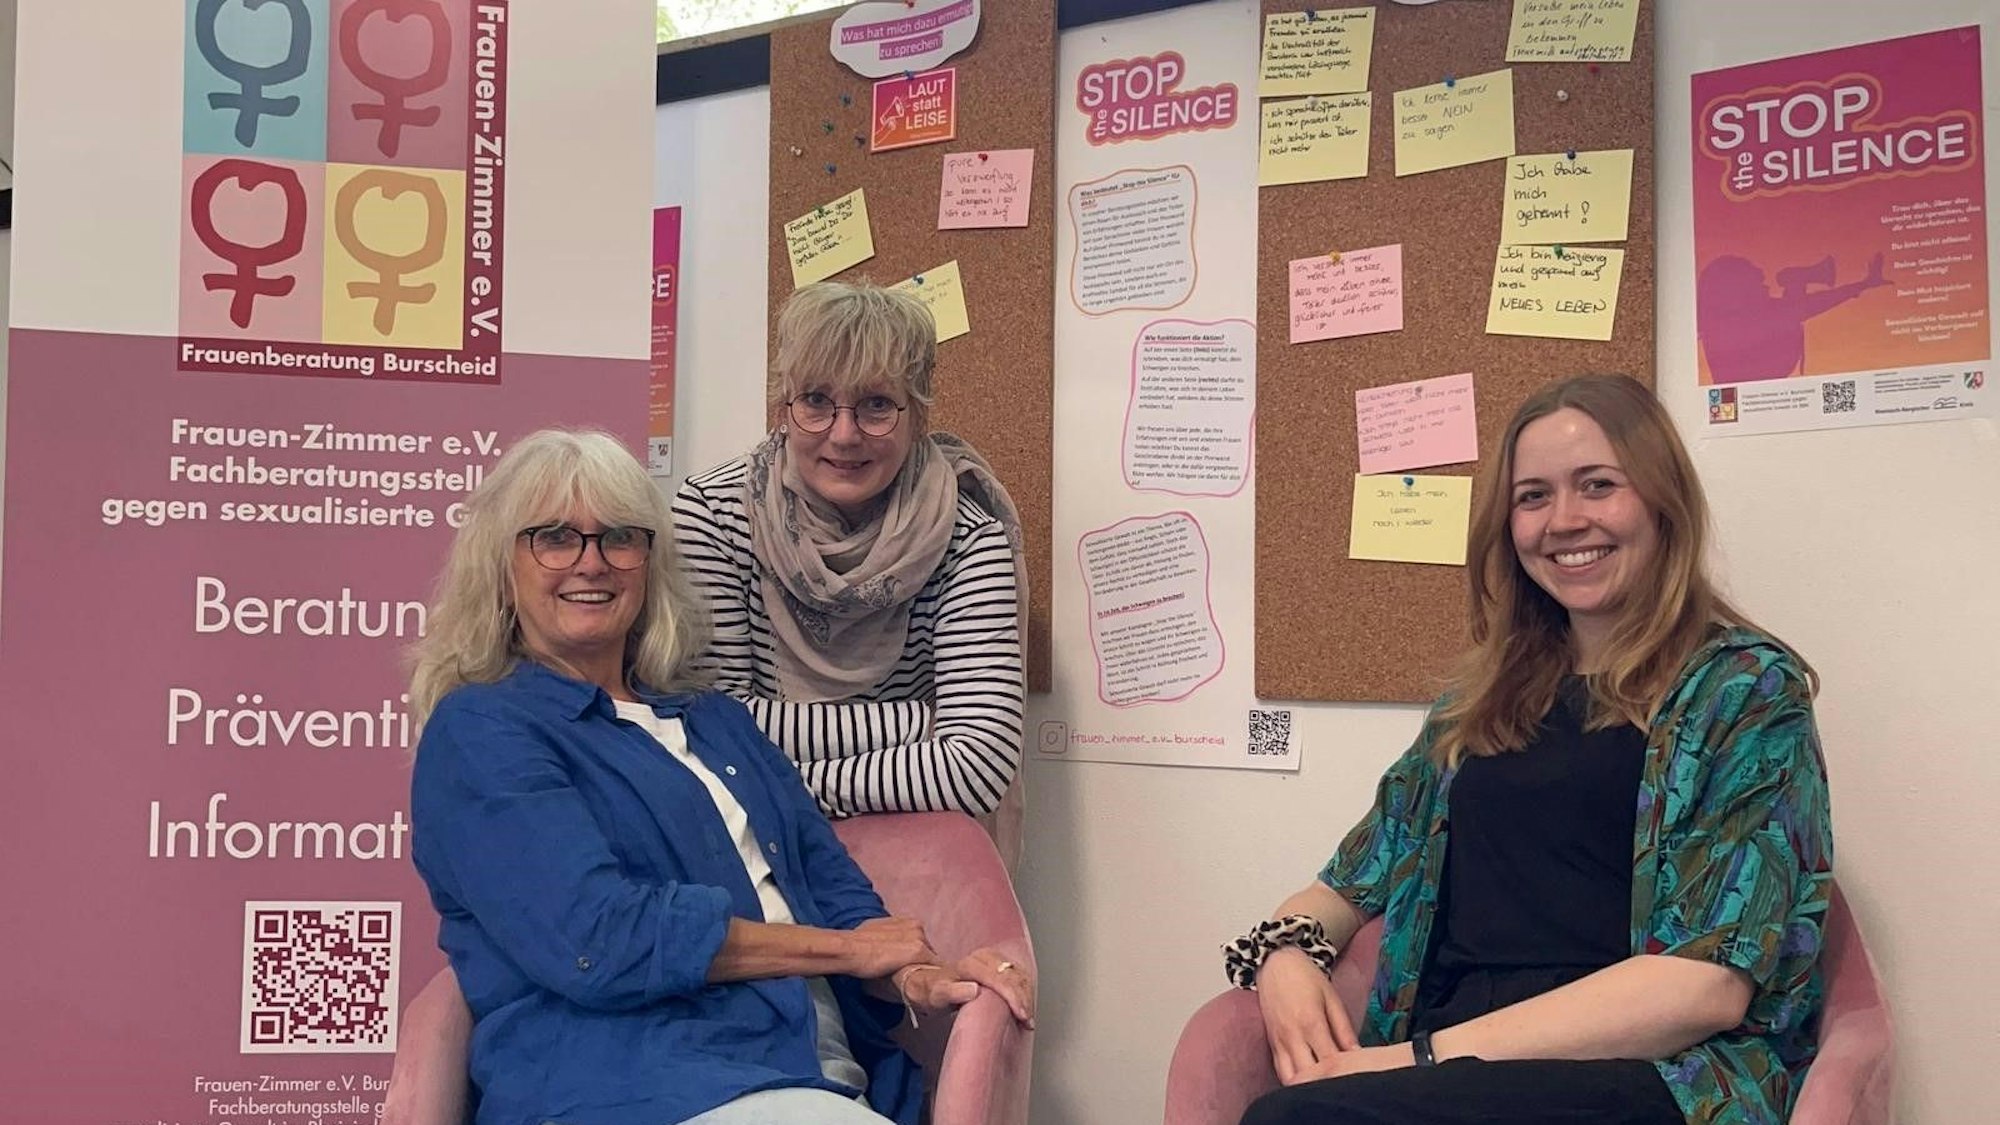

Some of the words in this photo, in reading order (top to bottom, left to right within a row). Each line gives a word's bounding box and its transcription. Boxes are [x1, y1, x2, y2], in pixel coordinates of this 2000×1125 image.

[841, 30, 864, 42] Was
[867, 28, 884, 40] hat
[886, 22, 912, 35] mich
[914, 18, 937, 31] dazu
[880, 47, 892, 57] zu
[909, 79, 946, 98] LAUT
[1083, 60, 1179, 107] STOP
[912, 96, 942, 112] statt
[1443, 102, 1473, 118] NEIN
[905, 110, 947, 130] LEISE
[1093, 108, 1107, 137] the
[1111, 92, 1231, 134] SILENCE
[1711, 86, 1870, 150] STOP
[471, 4, 505, 266] Frauen-Zimmer
[1424, 124, 1455, 141] sagen
[1733, 151, 1753, 190] the
[1762, 123, 1965, 184] SILENCE
[1514, 163, 1545, 180] Ich
[1514, 188, 1547, 200] mich
[1580, 200, 1590, 225] !
[1905, 219, 1956, 230] widerfahren
[1904, 240, 1919, 248] bist
[1920, 238, 1940, 246] nicht
[1941, 234, 1971, 244] alleine!
[1501, 247, 1523, 260] Ich
[1531, 247, 1552, 260] bin
[1894, 261, 1917, 269] Deine
[1918, 255, 1961, 266] Geschichte
[1500, 264, 1525, 274] und
[1580, 265, 1604, 281] auf
[1916, 266, 1949, 276] wichtig!
[470, 276, 500, 338] e.V.
[1499, 297, 1544, 311] NEUES
[1555, 298, 1607, 314] LEBEN
[1938, 311, 1969, 321] Gewalt
[1890, 327, 1910, 335] nicht
[181, 343, 375, 375] Frauenberatung
[383, 353, 498, 377] Burscheid
[171, 418, 432, 454] Frauen-Zimmer
[442, 430, 502, 457] e.V.
[169, 456, 484, 496] Fachberatungsstell
[101, 499, 207, 527] gegen
[219, 497, 435, 527] sexualisierte
[446, 503, 472, 528] G
[195, 576, 428, 637] Beratun
[167, 687, 410, 748] Präventi
[149, 792, 409, 860] Informat
[195, 1074, 320, 1093] Frauen-Zimmer
[325, 1074, 357, 1092] e.V.
[363, 1074, 390, 1092] Bur
[209, 1097, 369, 1118] Fachberatungsstelle
[375, 1103, 386, 1119] g
